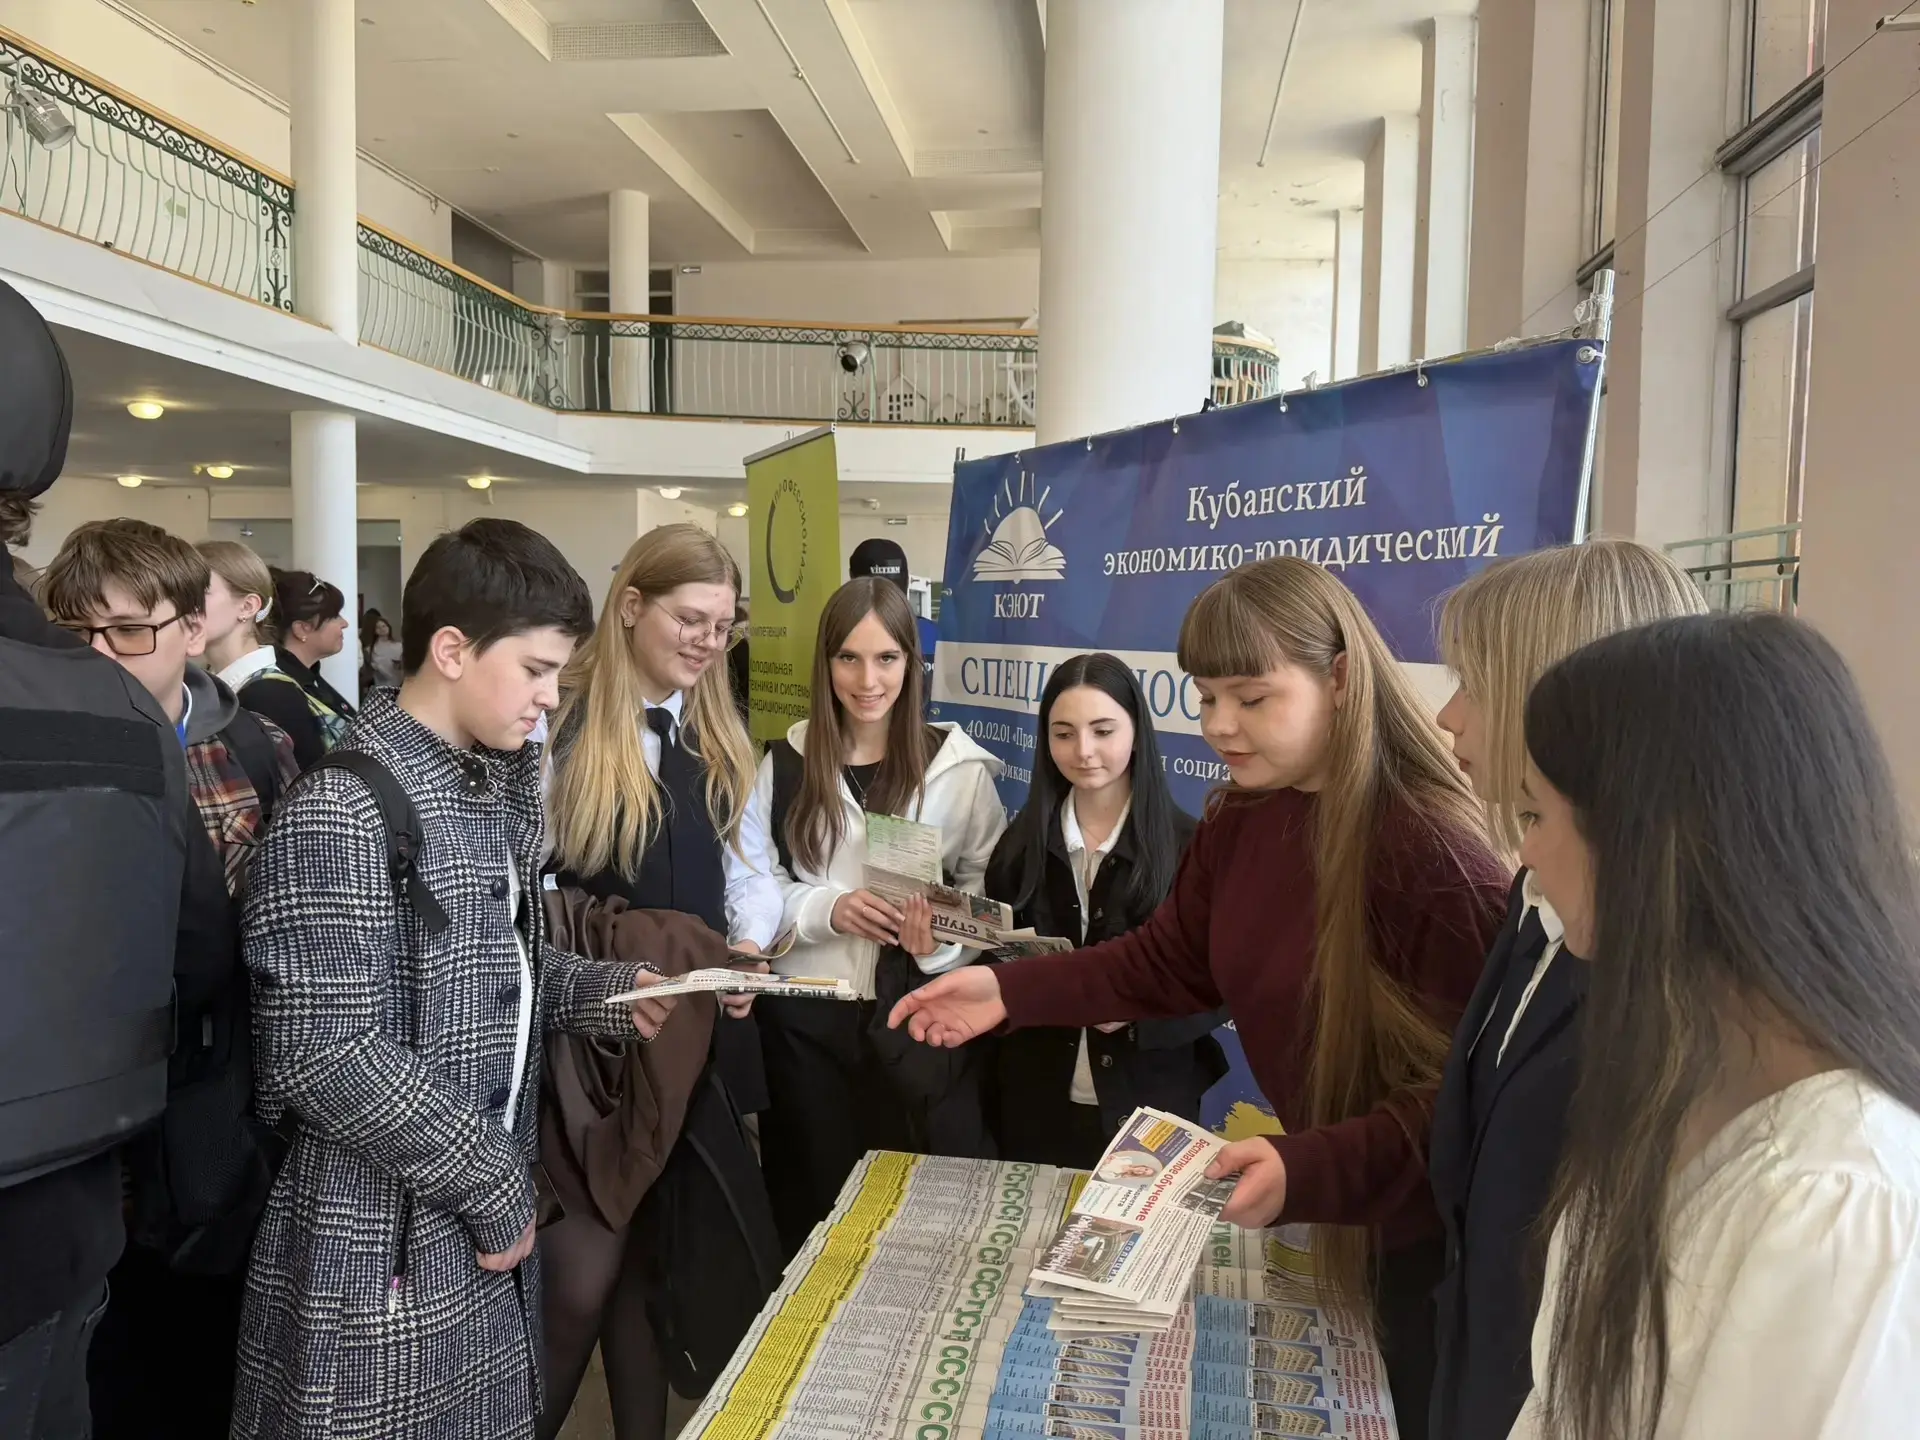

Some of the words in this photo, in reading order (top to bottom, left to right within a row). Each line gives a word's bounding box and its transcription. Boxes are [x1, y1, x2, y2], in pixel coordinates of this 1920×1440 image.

[1186, 465, 1368, 530] Кубанский
[1103, 512, 1505, 577] экономико-юридический
[993, 593, 1045, 619] КЭЮТ
[966, 719, 1011, 743] 40.02.01
[1169, 1137, 1211, 1176] Бесплатное
[1134, 1172, 1176, 1223] обучение
